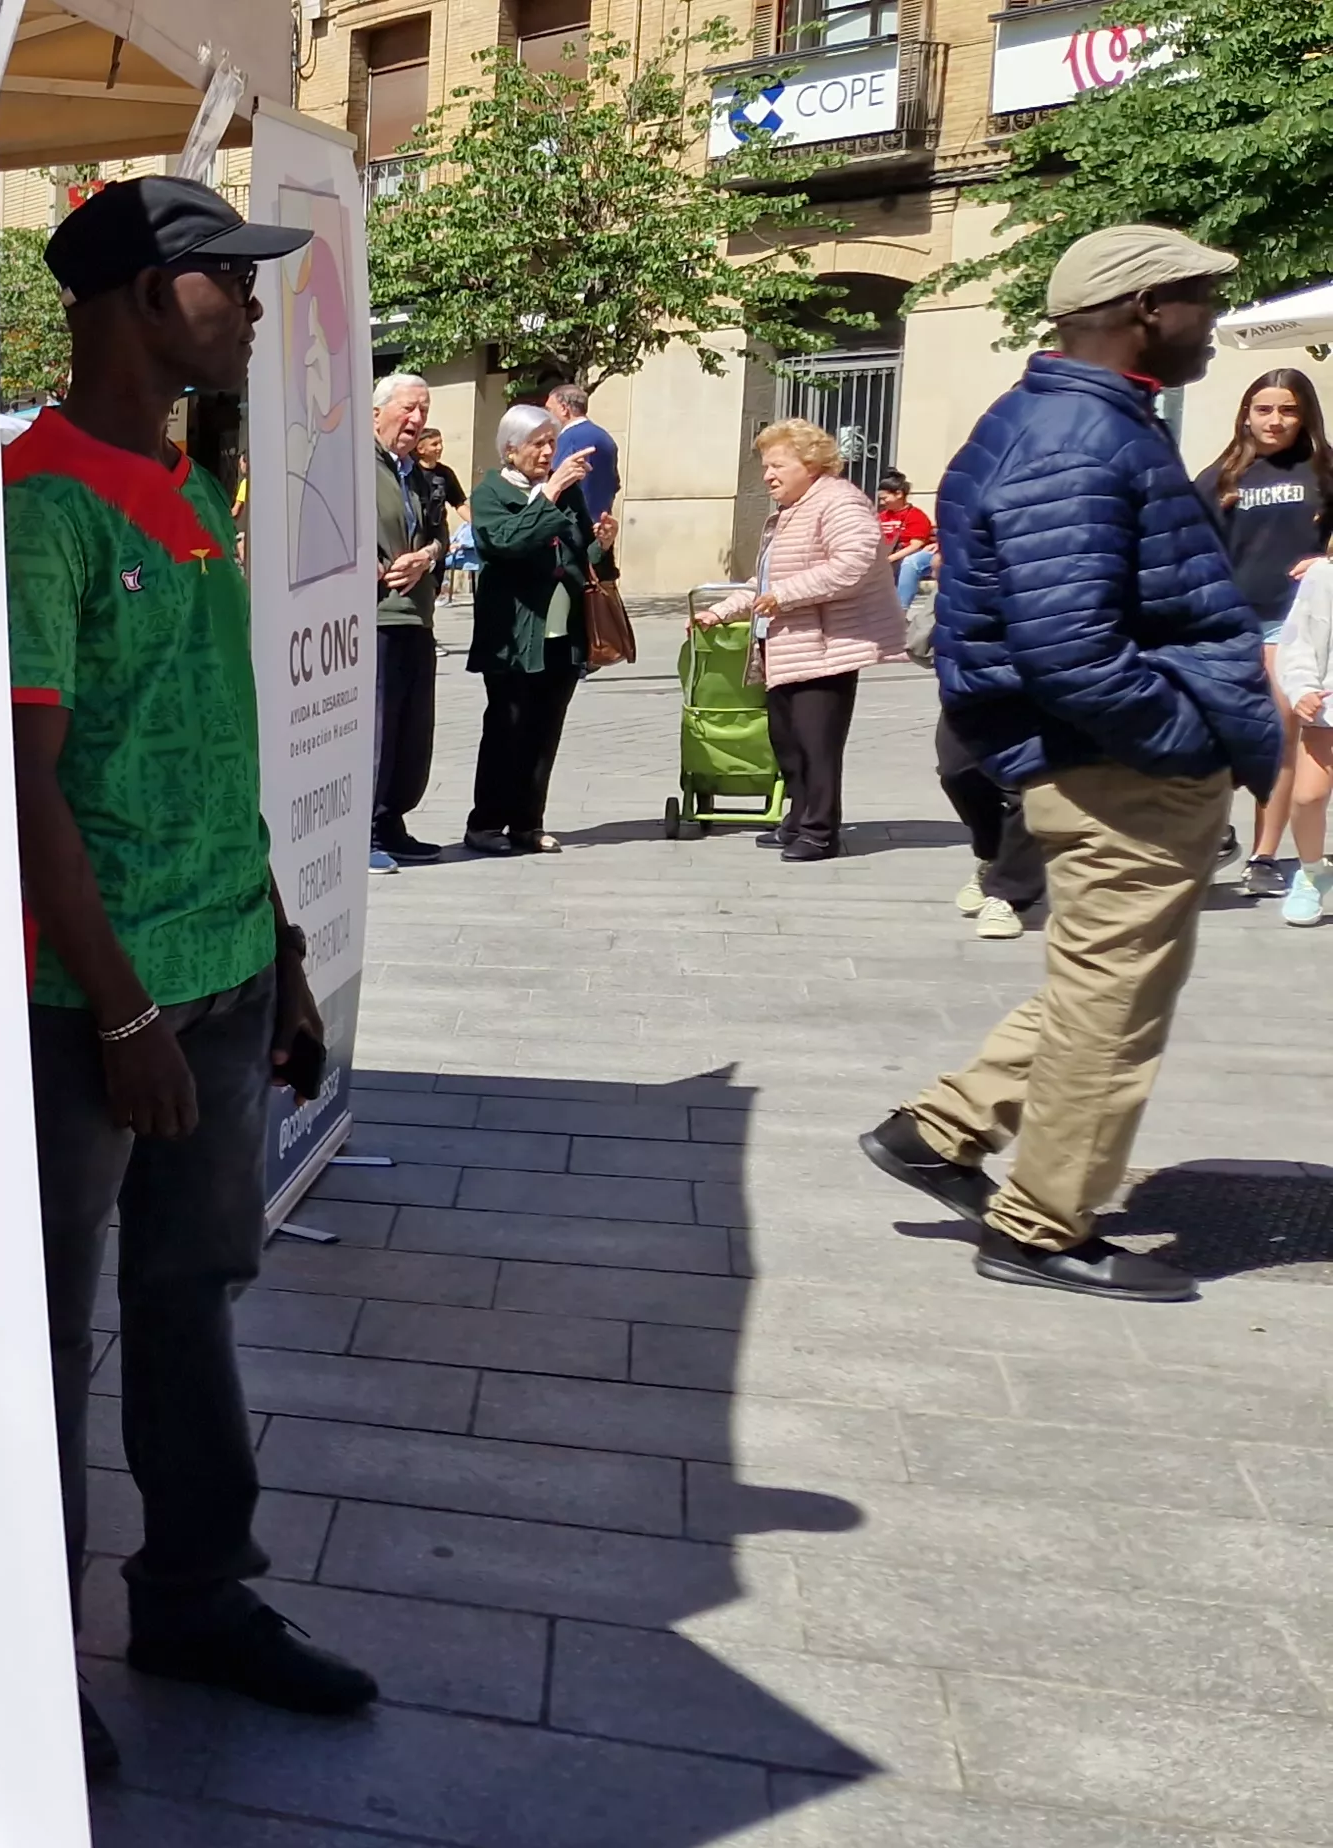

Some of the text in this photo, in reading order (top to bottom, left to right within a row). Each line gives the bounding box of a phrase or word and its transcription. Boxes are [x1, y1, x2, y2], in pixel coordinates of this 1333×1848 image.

[796, 72, 886, 117] COPE
[1237, 482, 1305, 511] WICKED
[289, 613, 359, 687] CC ONG
[290, 703, 310, 726] AYUDA
[322, 686, 358, 714] DESARROLLO
[290, 727, 332, 759] Delegación
[290, 772, 352, 844] COMPROMISO
[298, 840, 342, 910] CERCANÍA
